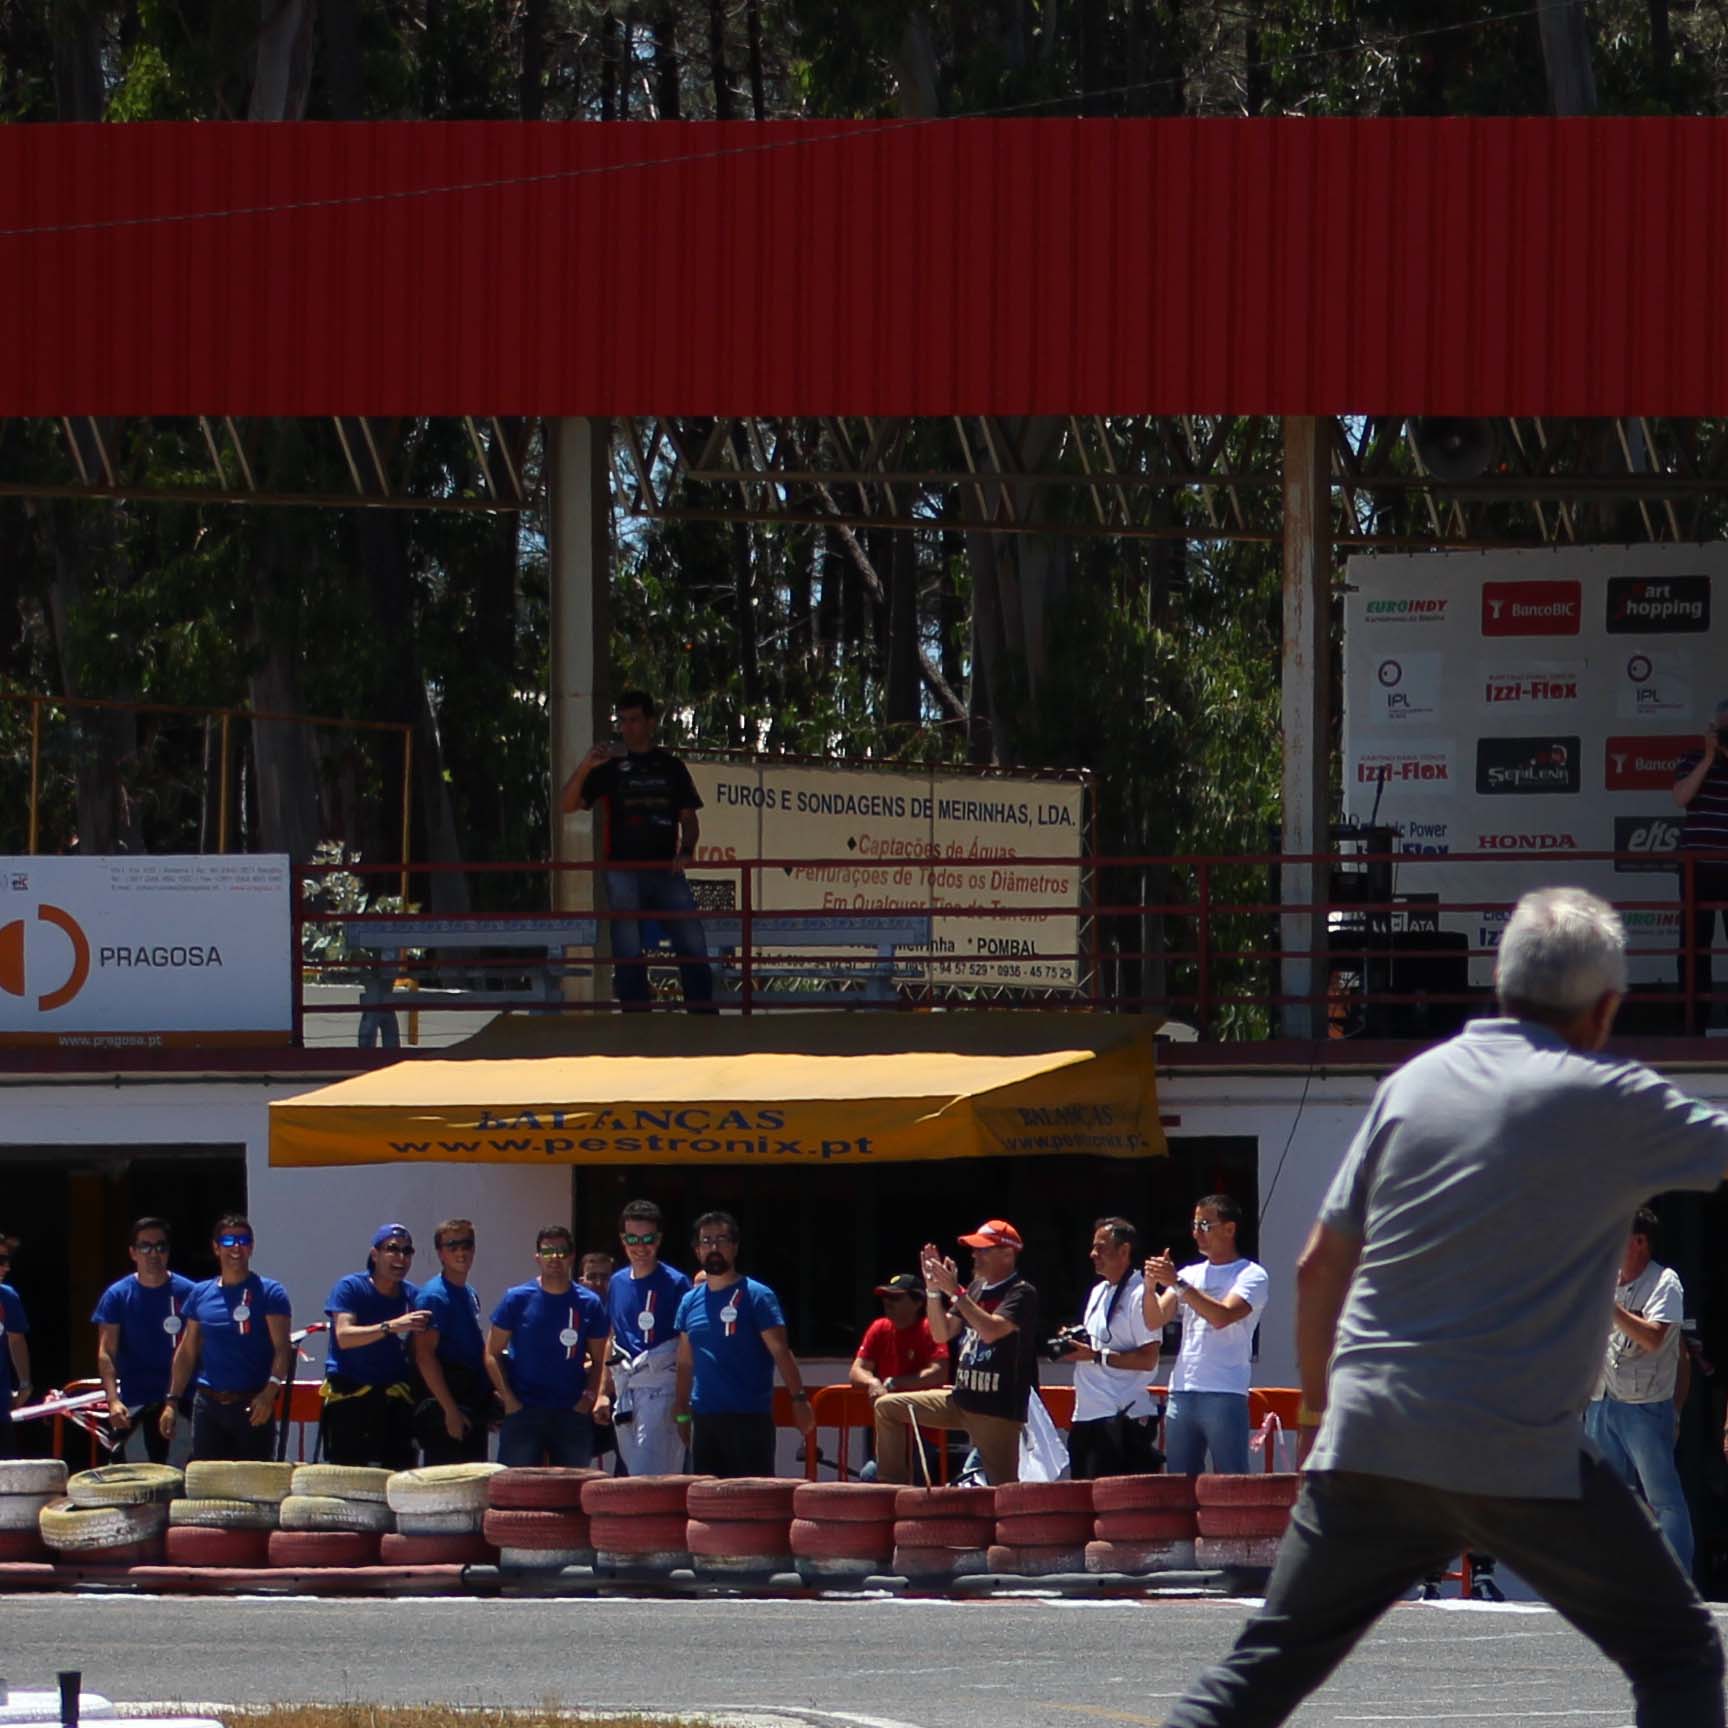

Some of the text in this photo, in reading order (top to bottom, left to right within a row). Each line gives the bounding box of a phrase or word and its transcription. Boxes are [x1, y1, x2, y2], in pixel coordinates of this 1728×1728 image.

[1366, 599, 1449, 614] EUROINDY
[1511, 602, 1575, 618] BancoBIC
[1635, 757, 1682, 771] Banco
[716, 784, 1076, 828] FUROS E SONDAGENS DE MEIRINHAS, LDA.
[1410, 821, 1448, 838] Power
[858, 833, 941, 860] Captações
[946, 840, 963, 859] de
[1479, 833, 1578, 849] HONDA
[893, 868, 912, 886] de
[920, 867, 963, 889] Todos
[968, 875, 986, 890] os
[990, 868, 1069, 894] Diâmetros
[977, 937, 1039, 956] POMBAL
[100, 946, 223, 967] PRAGOSA
[389, 1133, 874, 1157] www.pestronix.pt
